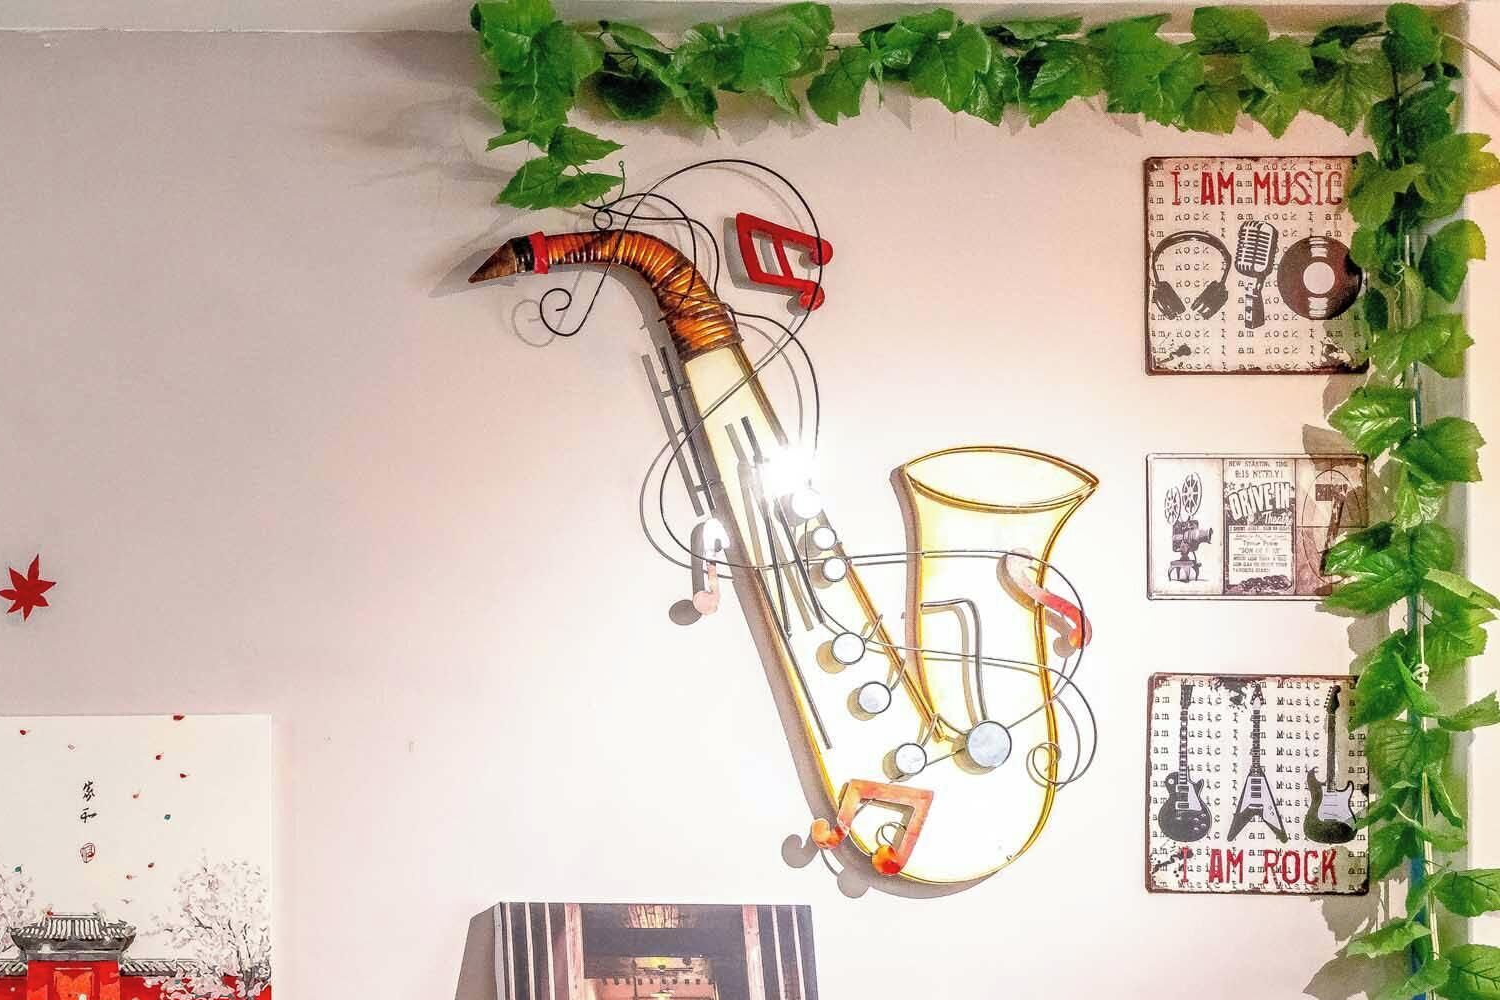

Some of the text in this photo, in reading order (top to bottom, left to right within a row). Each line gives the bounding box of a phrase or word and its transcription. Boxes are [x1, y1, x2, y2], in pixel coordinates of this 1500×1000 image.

[1170, 170, 1343, 206] I AM MUSIC
[1227, 481, 1290, 521] DRIVE-IN
[1181, 847, 1337, 885] I AM ROCK
